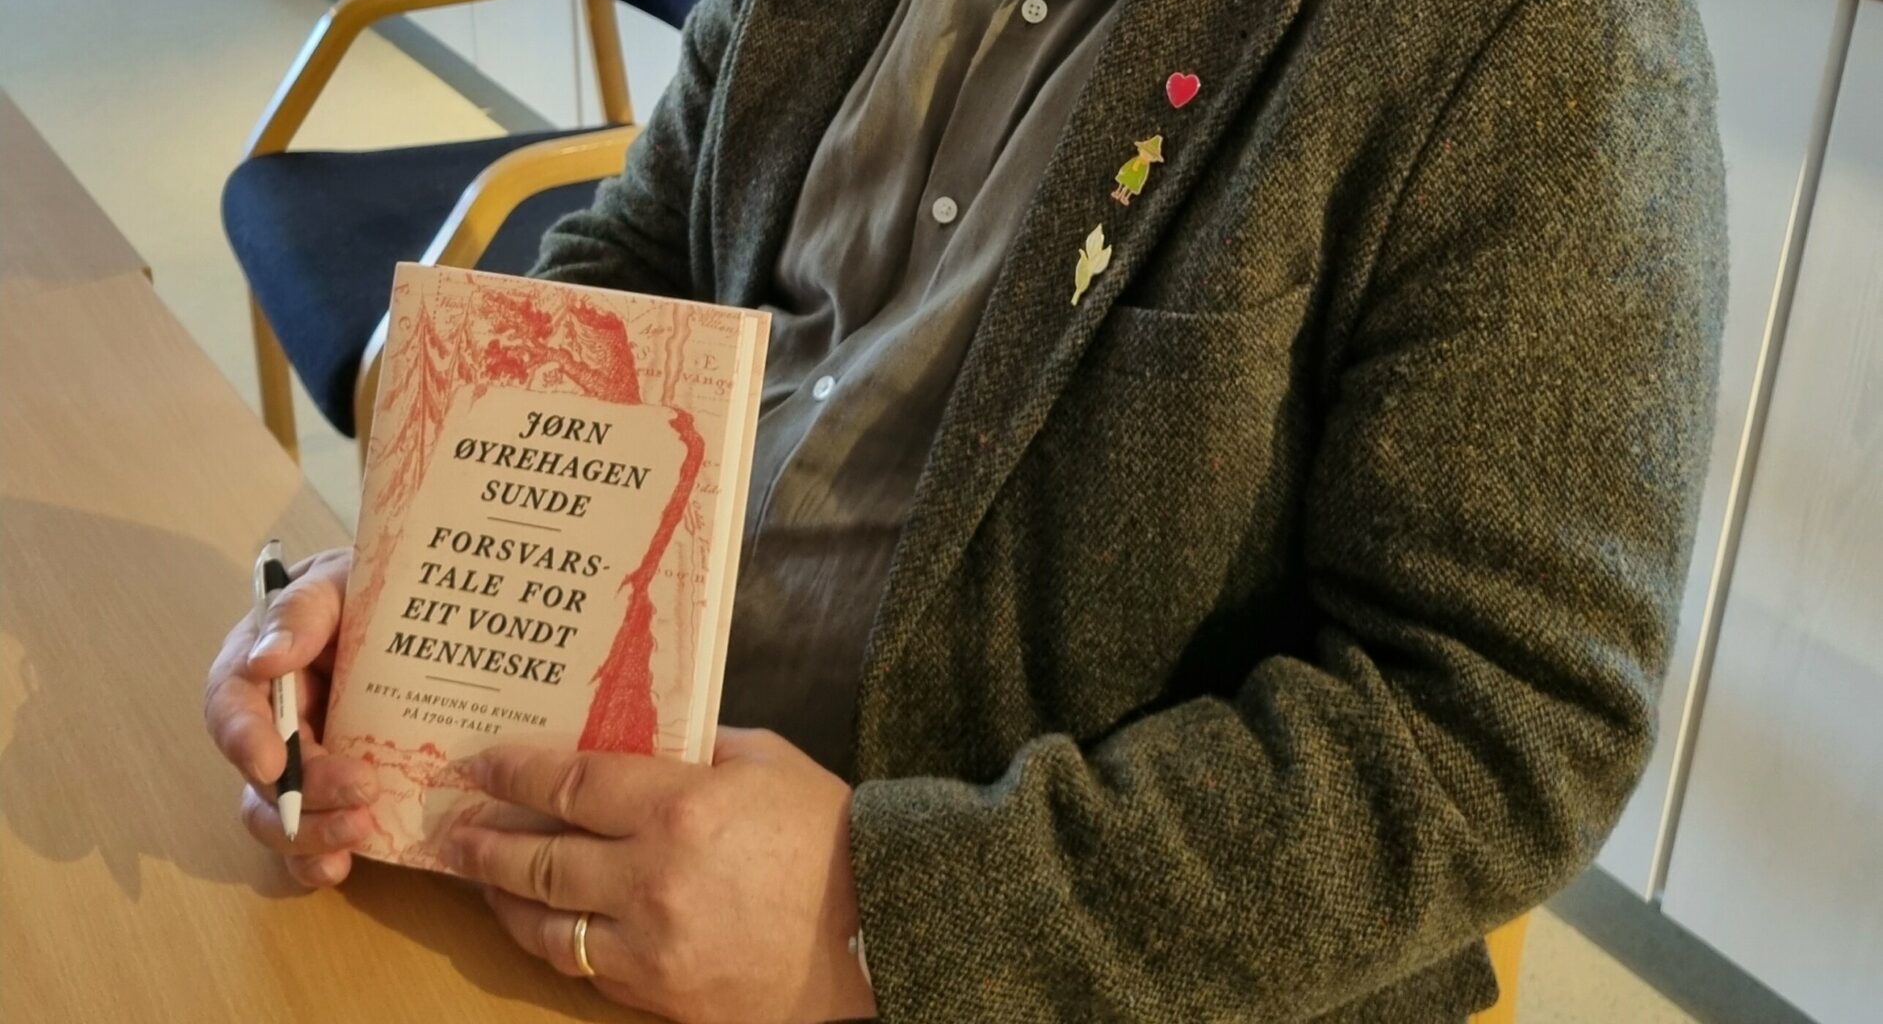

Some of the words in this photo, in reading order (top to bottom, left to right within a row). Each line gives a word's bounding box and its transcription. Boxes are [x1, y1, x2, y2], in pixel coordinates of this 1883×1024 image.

[519, 411, 613, 445] JØRN
[453, 437, 651, 490] ØYREHAGEN
[480, 479, 591, 518] SUNDE
[427, 526, 610, 577] FORSVARS-
[418, 562, 505, 597] TALE
[518, 581, 588, 614] FOR
[401, 597, 460, 627] EIT
[468, 608, 578, 649] VONDT
[385, 631, 567, 686] MENNESKE
[365, 683, 401, 699] RETT,
[405, 691, 468, 710] SAMFUNN
[470, 702, 489, 714] OG
[491, 706, 548, 727] KVINNER
[402, 707, 420, 720] PÅ
[422, 711, 502, 735] 1700-TALET
